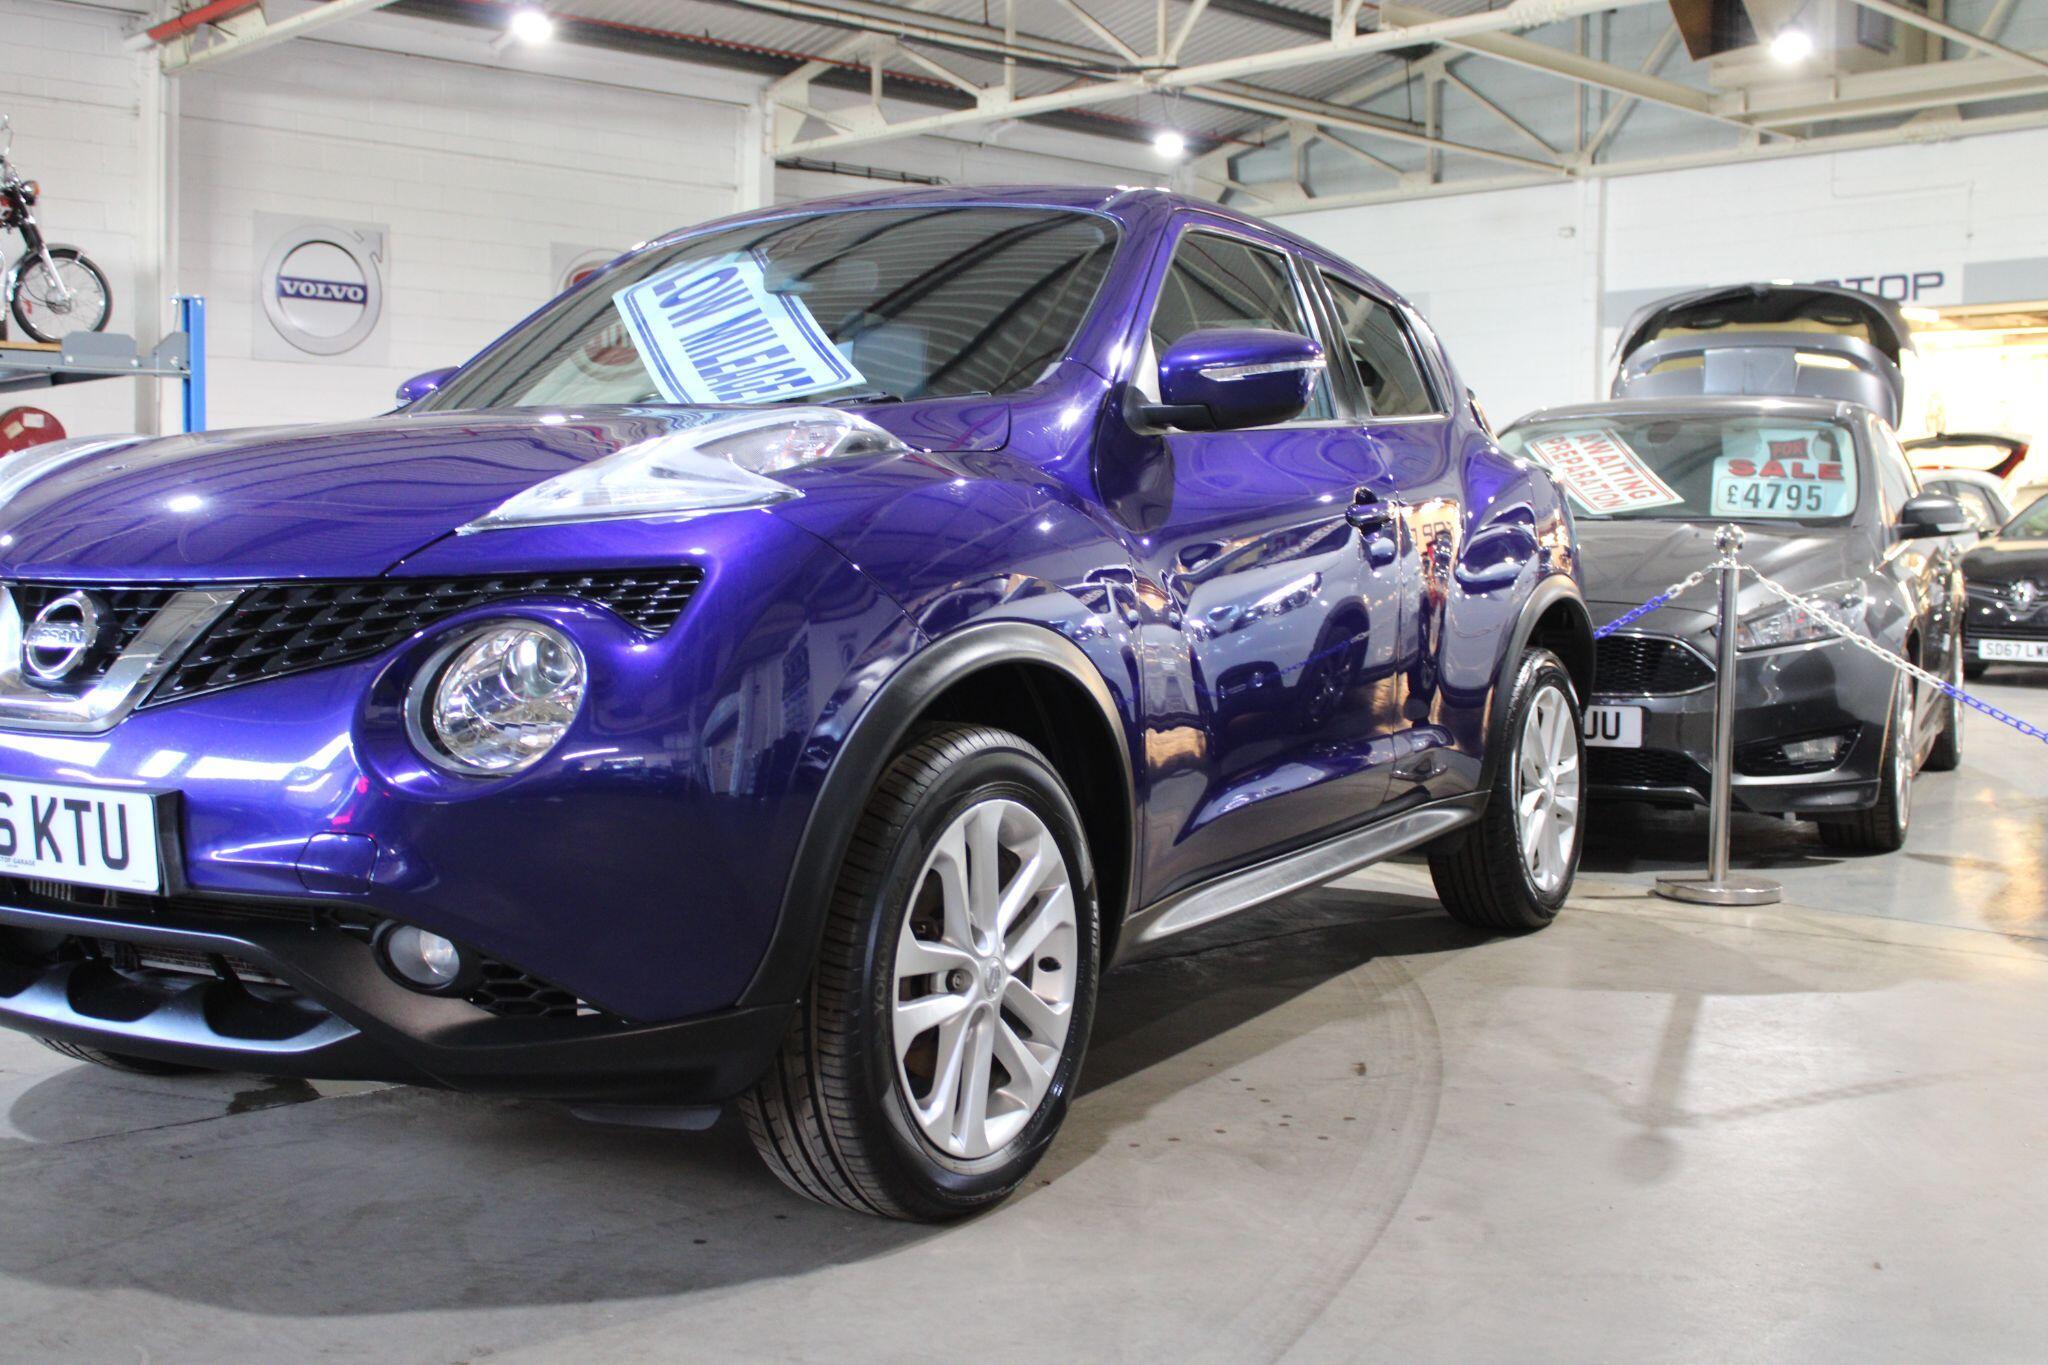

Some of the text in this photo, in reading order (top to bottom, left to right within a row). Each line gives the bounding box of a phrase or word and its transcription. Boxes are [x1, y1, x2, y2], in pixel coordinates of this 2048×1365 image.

[280, 279, 365, 302] VOLVO
[1813, 271, 1944, 301] TOP
[651, 255, 816, 402] LOW MILEAGE
[1770, 440, 1806, 458] FOR
[1543, 435, 1629, 508] PREPARATION
[1574, 433, 1657, 500] AWAITING
[1727, 459, 1844, 480] SALE
[1727, 482, 1822, 511] £4795
[1986, 642, 2048, 658] SD67 LW
[31, 795, 130, 871] KTU
